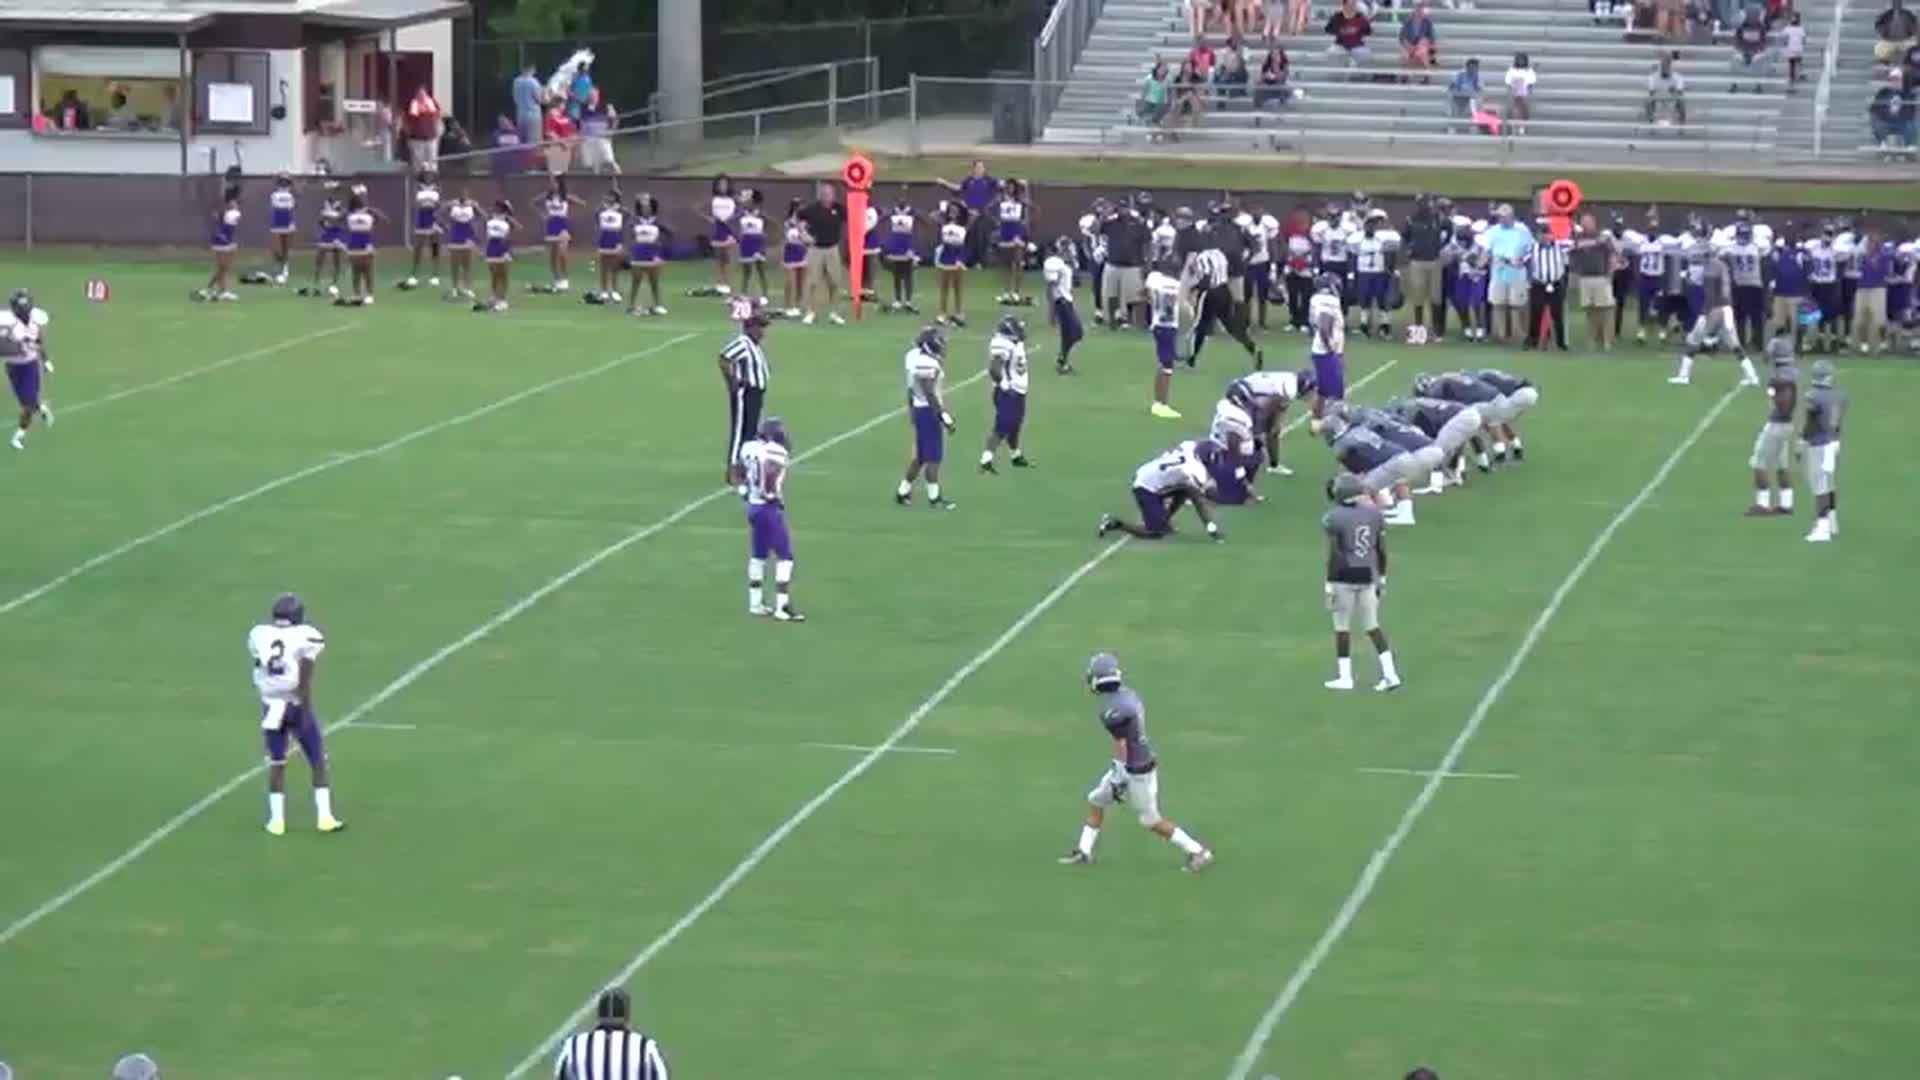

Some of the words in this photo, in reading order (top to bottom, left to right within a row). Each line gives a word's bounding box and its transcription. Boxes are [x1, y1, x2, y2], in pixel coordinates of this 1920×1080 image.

[87, 281, 106, 300] 10
[732, 299, 752, 320] 20
[1407, 324, 1427, 344] 30
[1353, 524, 1371, 559] 5
[267, 638, 286, 676] 2
